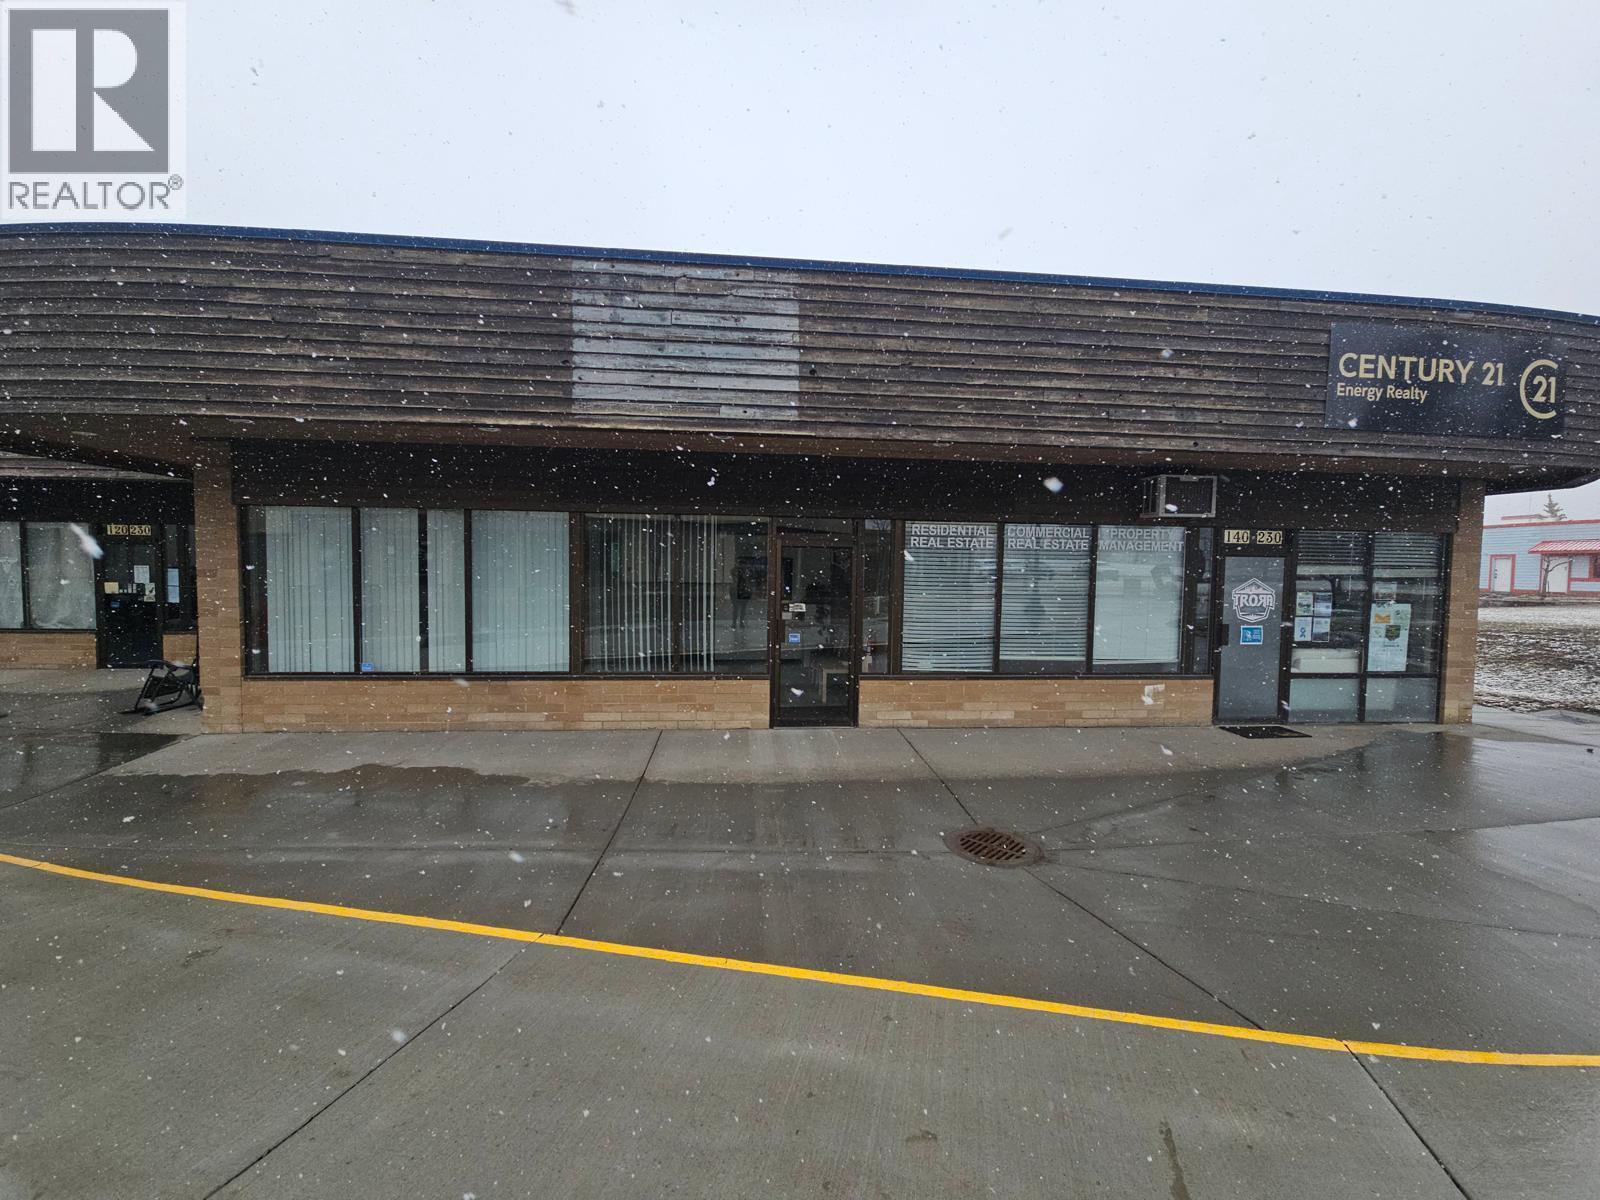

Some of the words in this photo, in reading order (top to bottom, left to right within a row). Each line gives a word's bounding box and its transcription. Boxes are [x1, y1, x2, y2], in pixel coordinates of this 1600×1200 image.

[1338, 352, 1475, 384] CENTURY
[1481, 362, 1504, 387] 21
[1336, 382, 1384, 402] Energy
[1386, 386, 1428, 404] Realty
[109, 525, 127, 535] 120
[911, 523, 993, 536] RESIDENTIAL
[1007, 525, 1090, 538] COMMERCIAL
[1110, 528, 1174, 540] PROPERTY
[910, 536, 944, 548] REAL
[947, 537, 994, 549] ESTATE
[1226, 530, 1249, 544] 140
[1258, 531, 1282, 544] 230
[1007, 538, 1041, 549] REAL
[1043, 539, 1089, 550] ESTATE
[1098, 540, 1185, 552] MANAGEMENT
